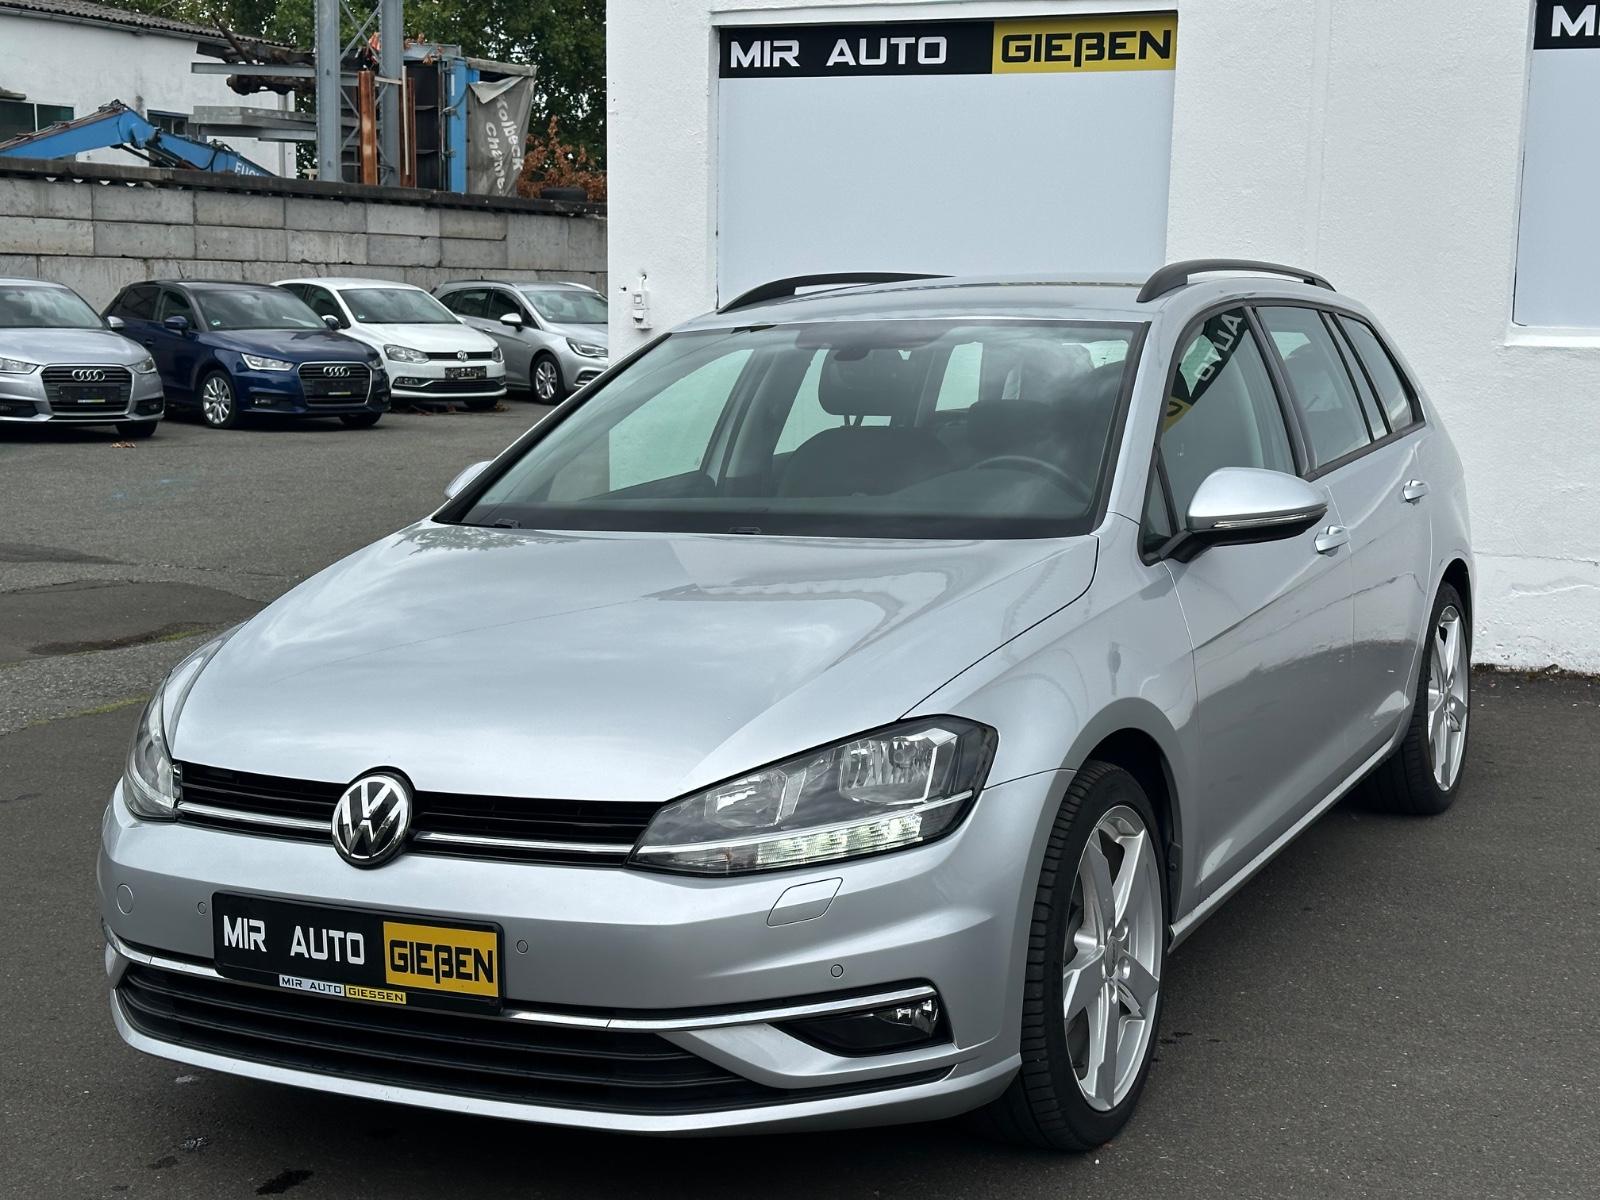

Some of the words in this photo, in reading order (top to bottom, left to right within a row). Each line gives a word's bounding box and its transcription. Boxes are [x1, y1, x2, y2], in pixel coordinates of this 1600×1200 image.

[1551, 4, 1600, 37] M
[729, 39, 801, 68] MIR
[825, 36, 948, 67] AUTO
[1001, 29, 1172, 68] GIEßEN
[223, 915, 268, 953] MIR
[289, 925, 365, 966] AUTO
[389, 939, 494, 984] GIEßEN
[281, 976, 303, 988] MIR
[309, 981, 342, 994] AUTO
[348, 987, 404, 1002] GIESSEN
